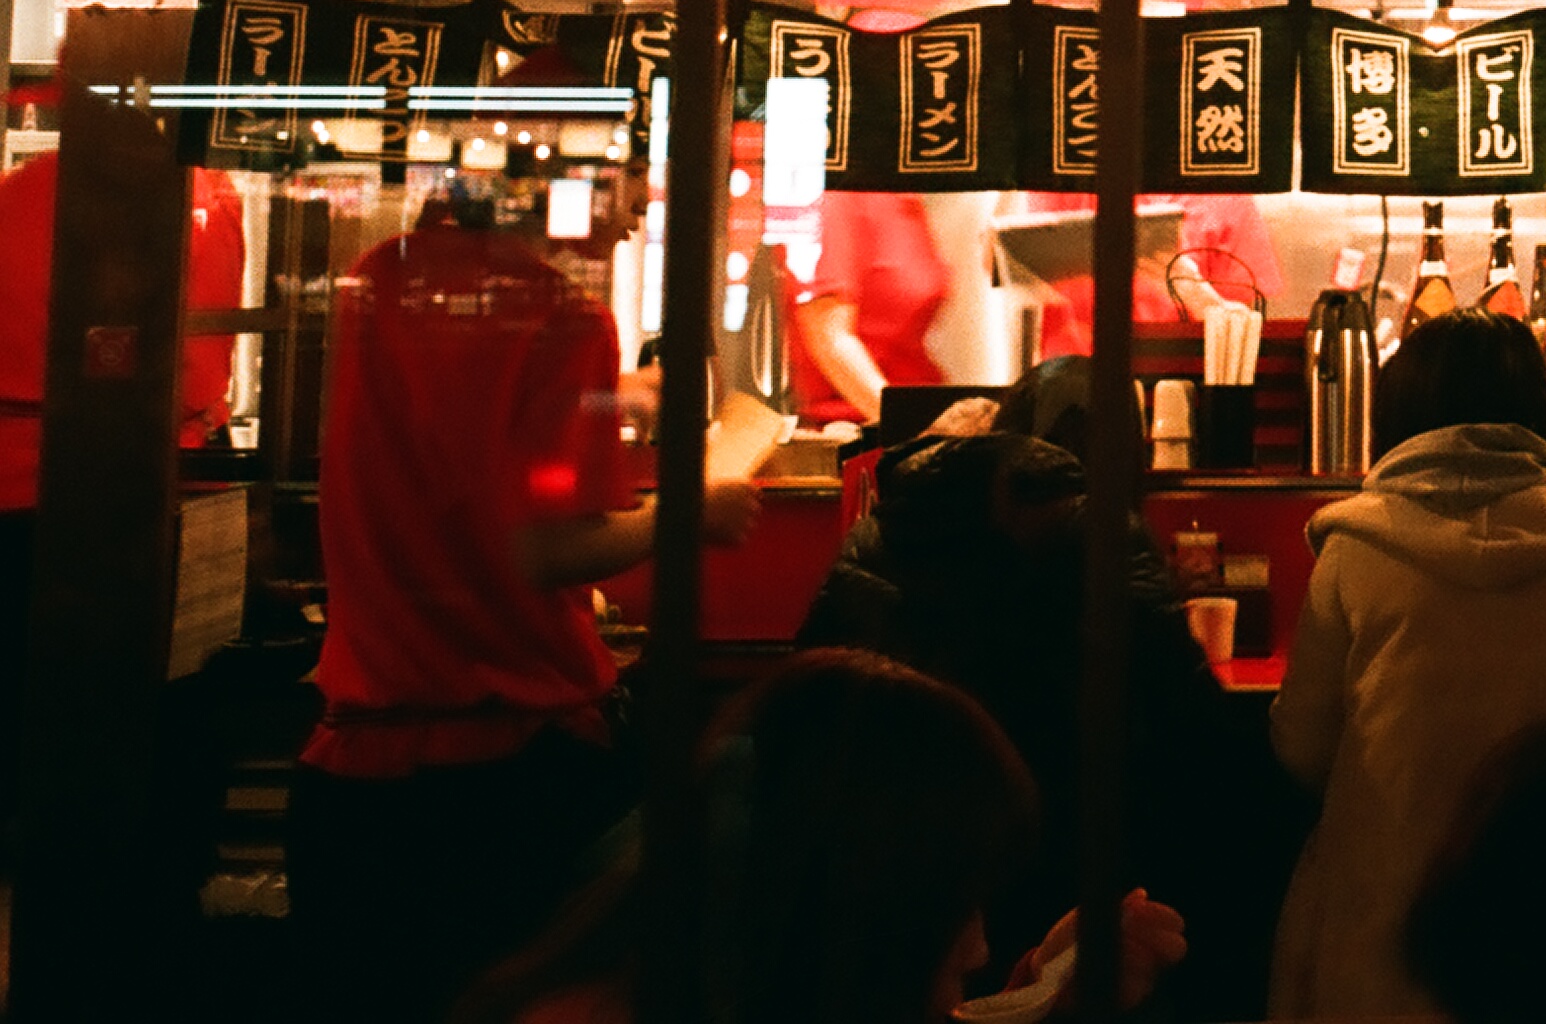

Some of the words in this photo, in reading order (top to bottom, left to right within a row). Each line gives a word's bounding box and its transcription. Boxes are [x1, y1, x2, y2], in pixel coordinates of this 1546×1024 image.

[917, 40, 961, 157] ラーメン
[1195, 46, 1245, 154] 天然
[1346, 46, 1395, 158] 博多
[1475, 45, 1520, 160] ビール
